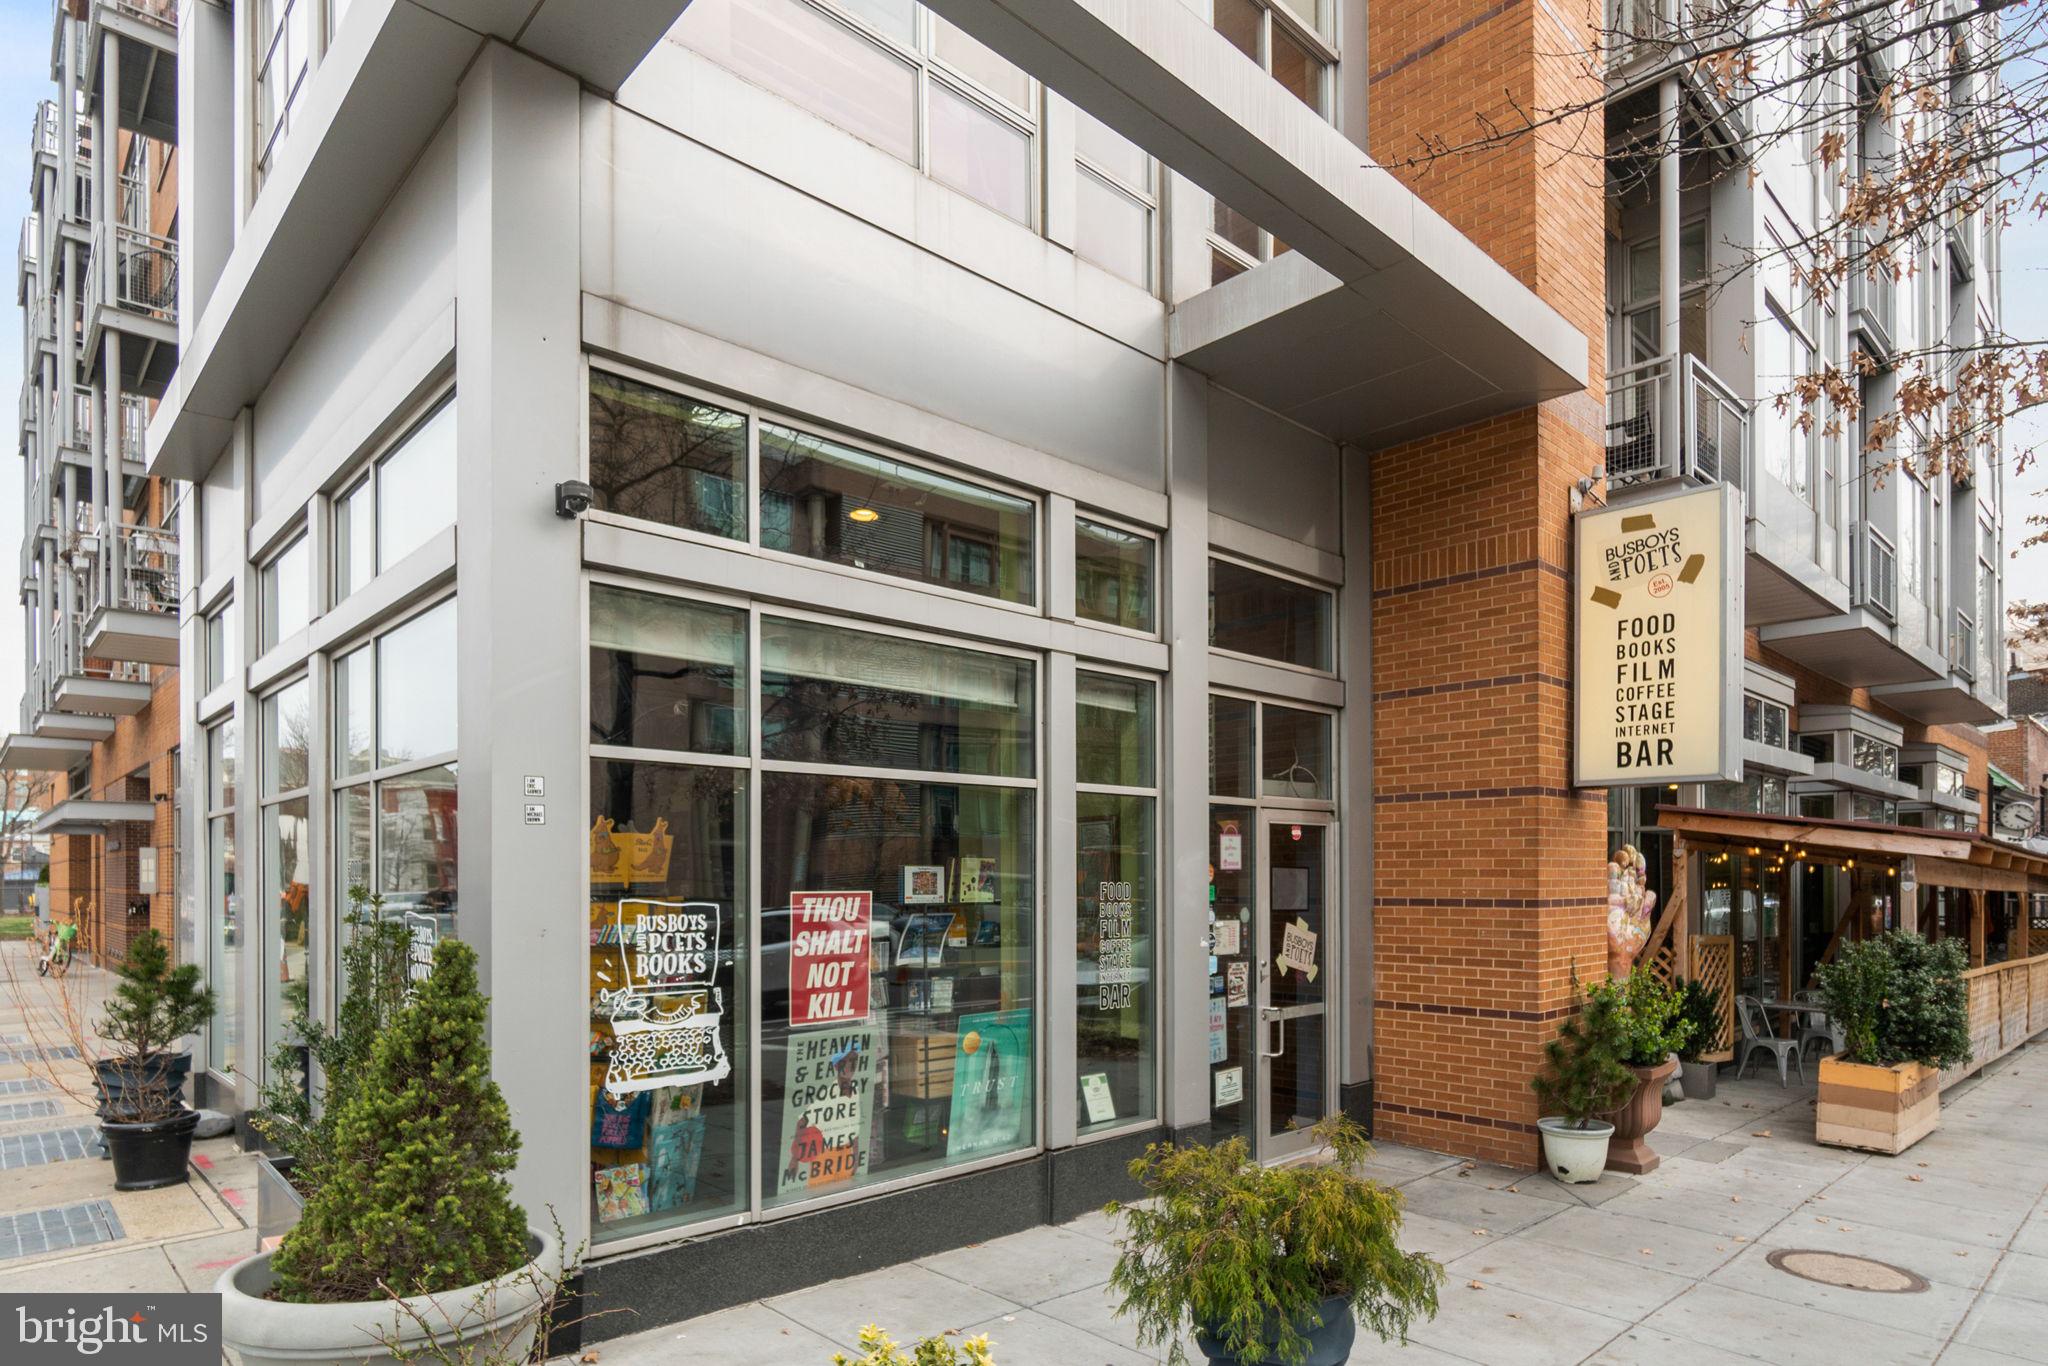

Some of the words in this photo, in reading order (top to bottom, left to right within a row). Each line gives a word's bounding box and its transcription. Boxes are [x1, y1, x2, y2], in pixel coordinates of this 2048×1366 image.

[1605, 527, 1680, 562] BUSBOYS
[1608, 561, 1621, 581] AND
[1621, 541, 1682, 579] POETS
[1617, 613, 1676, 640] FOOD
[1616, 637, 1676, 660] BOOKS
[1617, 658, 1675, 684] FILM
[1616, 682, 1676, 702] COFFEE
[1615, 701, 1675, 723] STAGE
[1615, 722, 1675, 738] INTERNET
[1616, 738, 1674, 768] BAR
[1100, 882, 1131, 901] FOOD
[803, 897, 861, 922] THOU
[1100, 902, 1131, 918] BOOKS
[636, 913, 708, 933] BUSBOYS
[1100, 919, 1131, 938] FILM
[794, 929, 867, 956] SHALT
[1100, 939, 1131, 955] COFFEE
[636, 953, 707, 978] BOOKS
[806, 961, 855, 989] NOT
[1100, 954, 1131, 971] STAGE
[807, 991, 855, 1019] KILL
[1100, 985, 1131, 1011] BAR
[797, 1041, 805, 1063] THE
[806, 1034, 871, 1060] HEAVEN
[795, 1066, 808, 1083] &
[815, 1055, 869, 1080] EARTH
[792, 1077, 869, 1107] GROCERY
[960, 1075, 1018, 1097] TRUST
[799, 1102, 856, 1129] STORE
[798, 1132, 856, 1159] JAMES
[782, 1151, 866, 1186] McBRIDE
